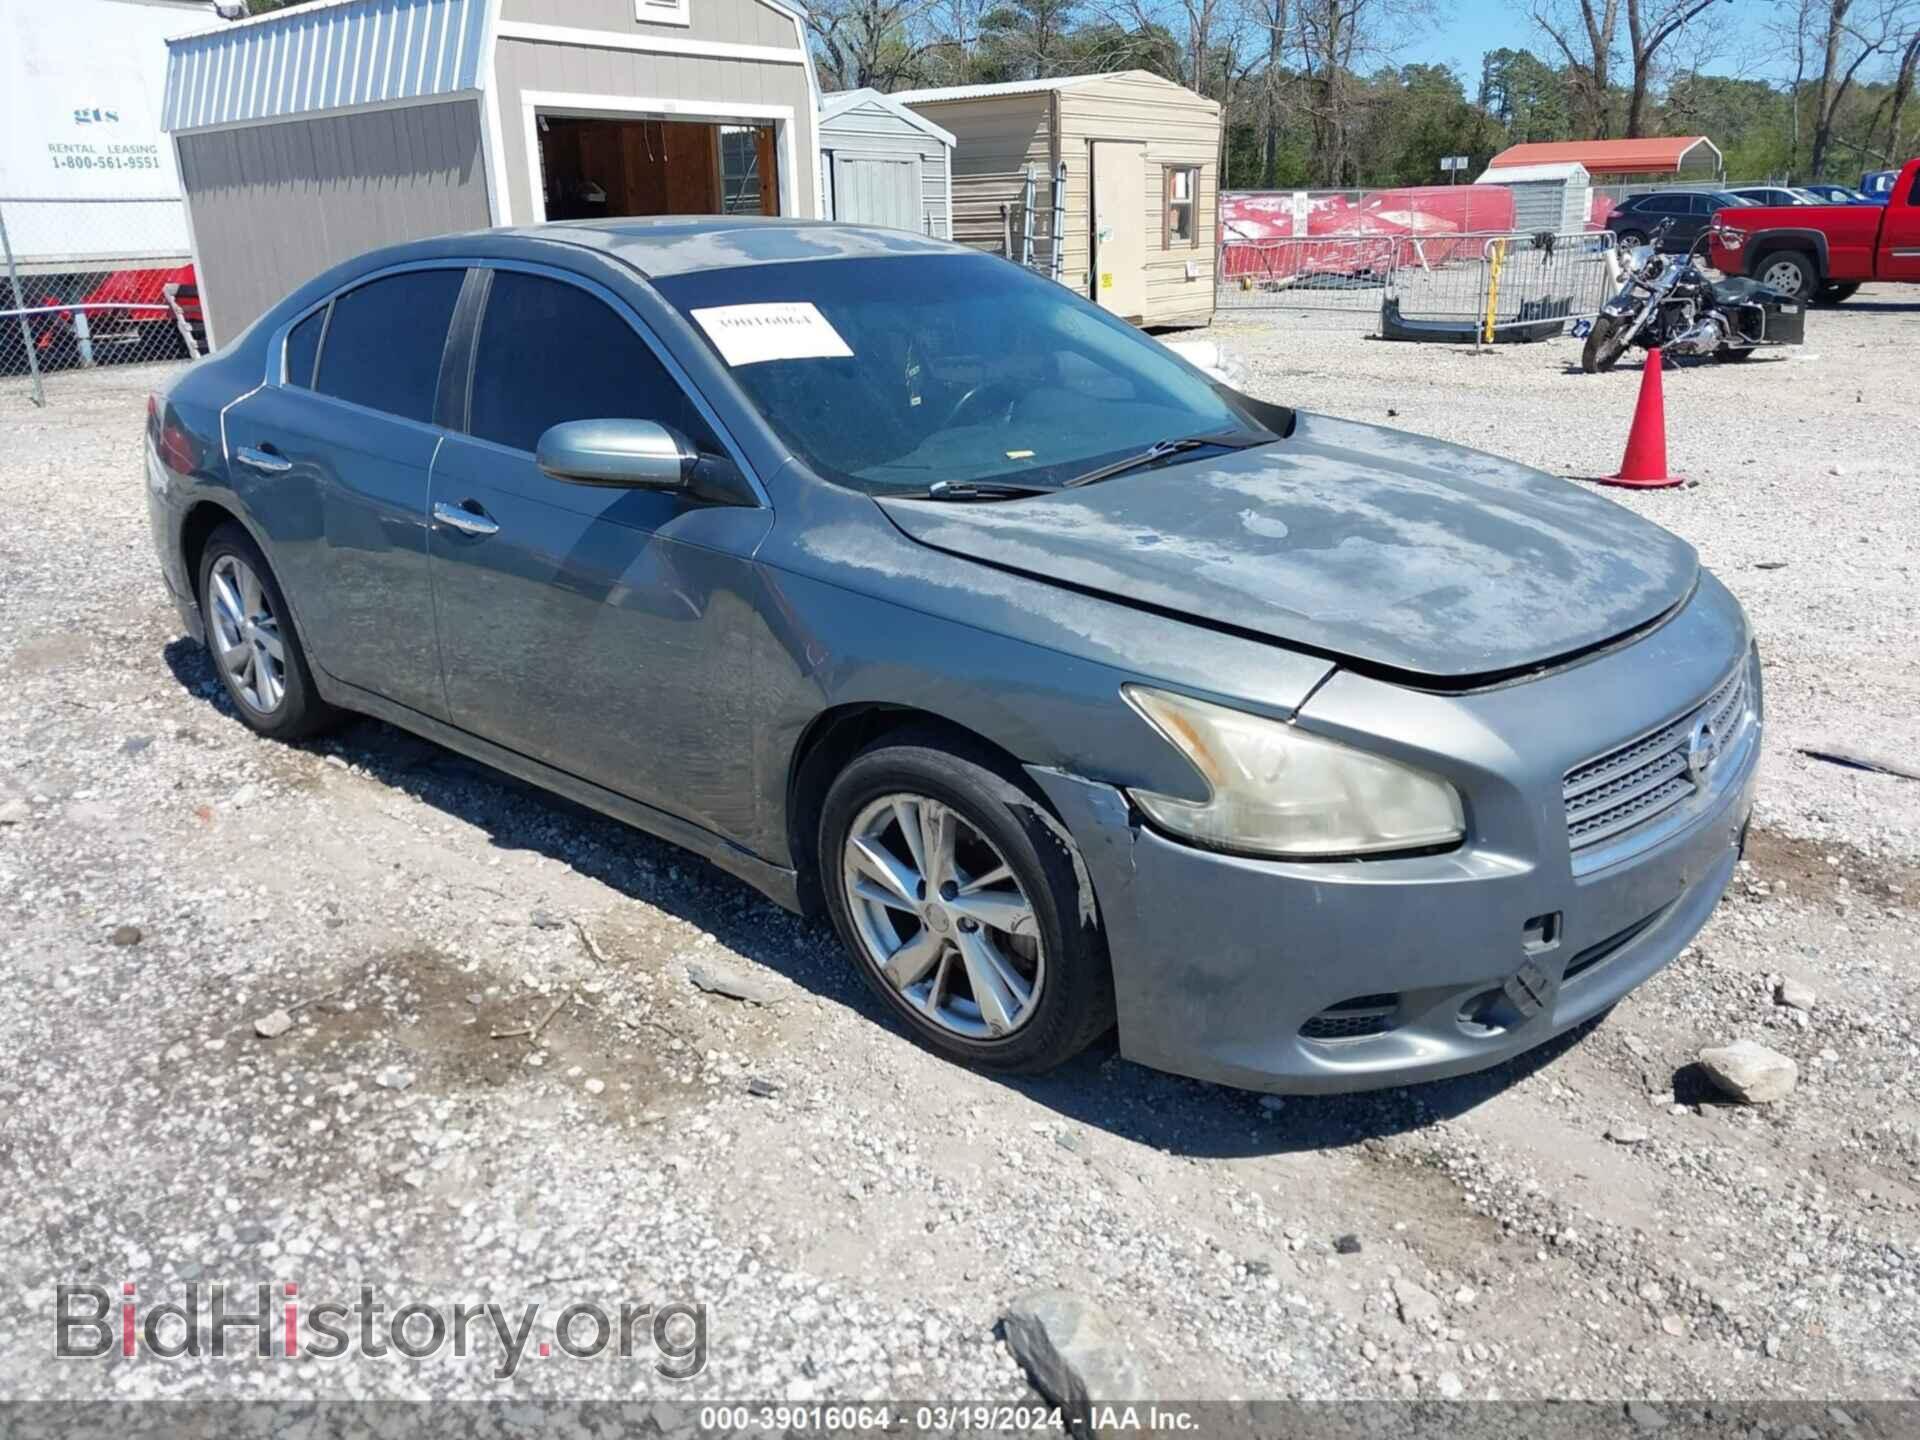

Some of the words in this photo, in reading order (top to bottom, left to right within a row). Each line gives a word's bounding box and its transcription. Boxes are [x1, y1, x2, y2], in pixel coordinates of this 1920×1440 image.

[48, 143, 96, 153] RENTAL
[107, 144, 158, 154] LEASING
[52, 156, 160, 169] 1-800-561-9551
